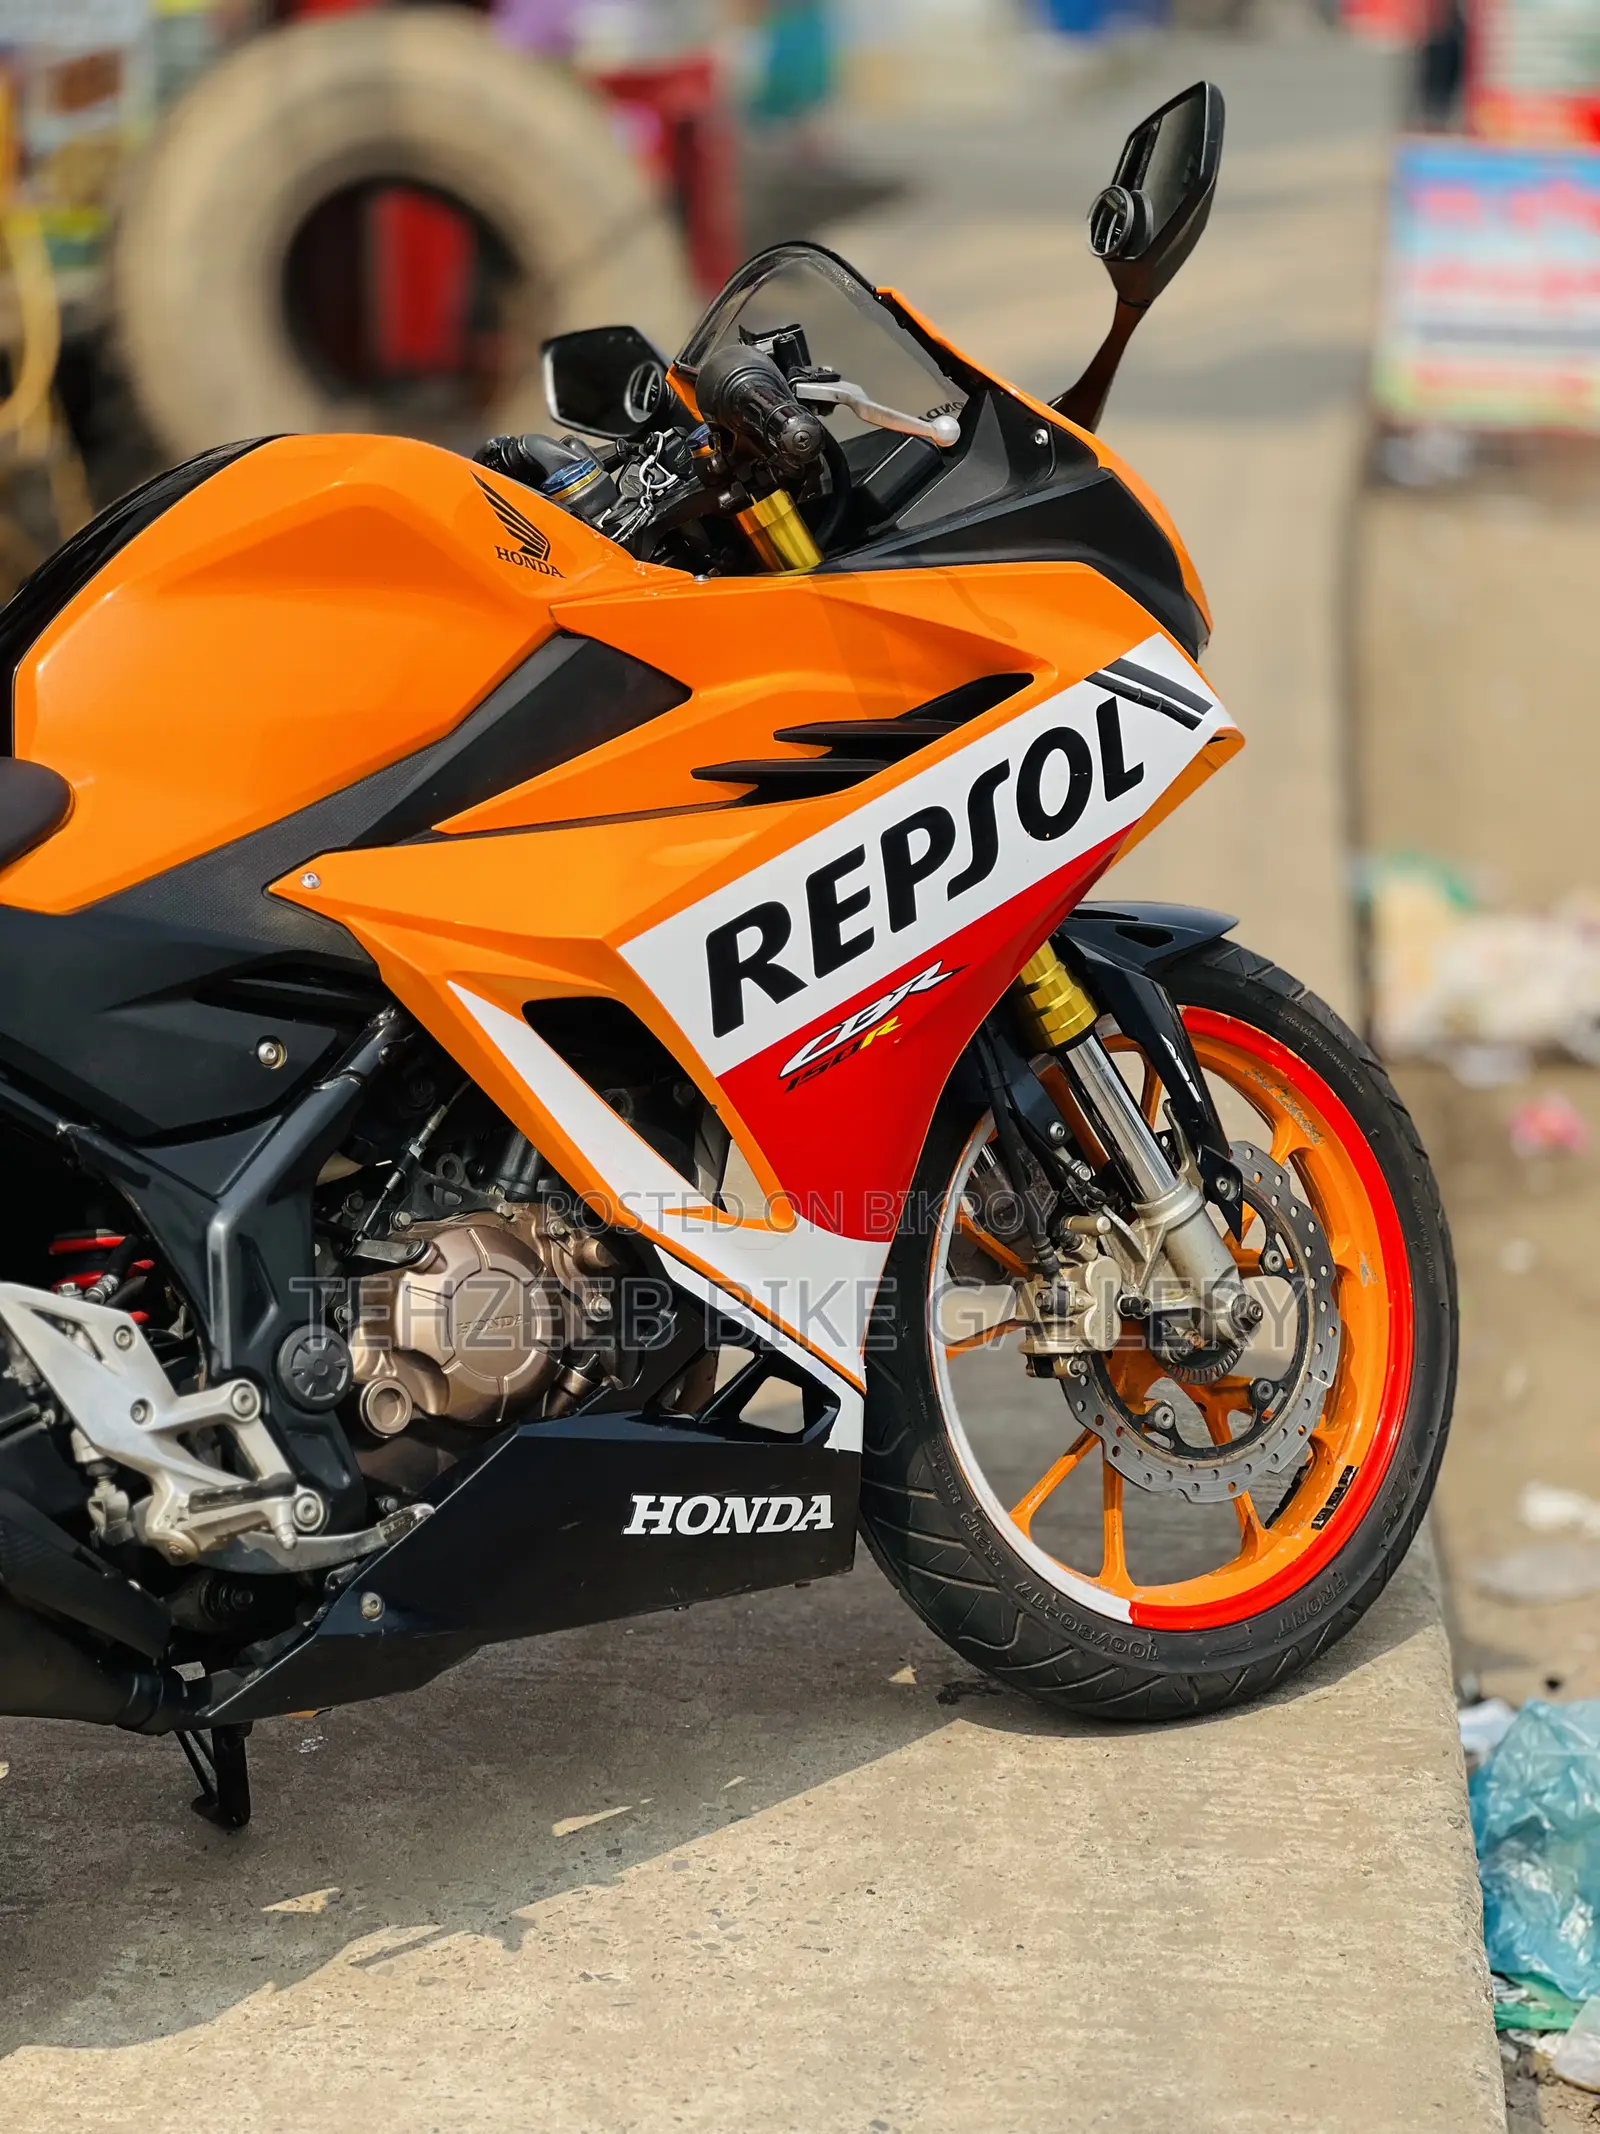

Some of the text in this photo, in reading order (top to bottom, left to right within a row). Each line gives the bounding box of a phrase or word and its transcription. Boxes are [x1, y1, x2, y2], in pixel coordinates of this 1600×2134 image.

[493, 544, 567, 579] HONDA
[705, 695, 1145, 1038] REPSOL
[778, 959, 971, 1080] CBR
[784, 1016, 903, 1094] 150R
[456, 1313, 531, 1336] HONDA
[622, 1494, 835, 1536] HONDA
[960, 1511, 1160, 1662] 100/80-17 52P
[1278, 1570, 1350, 1638] FRONT
